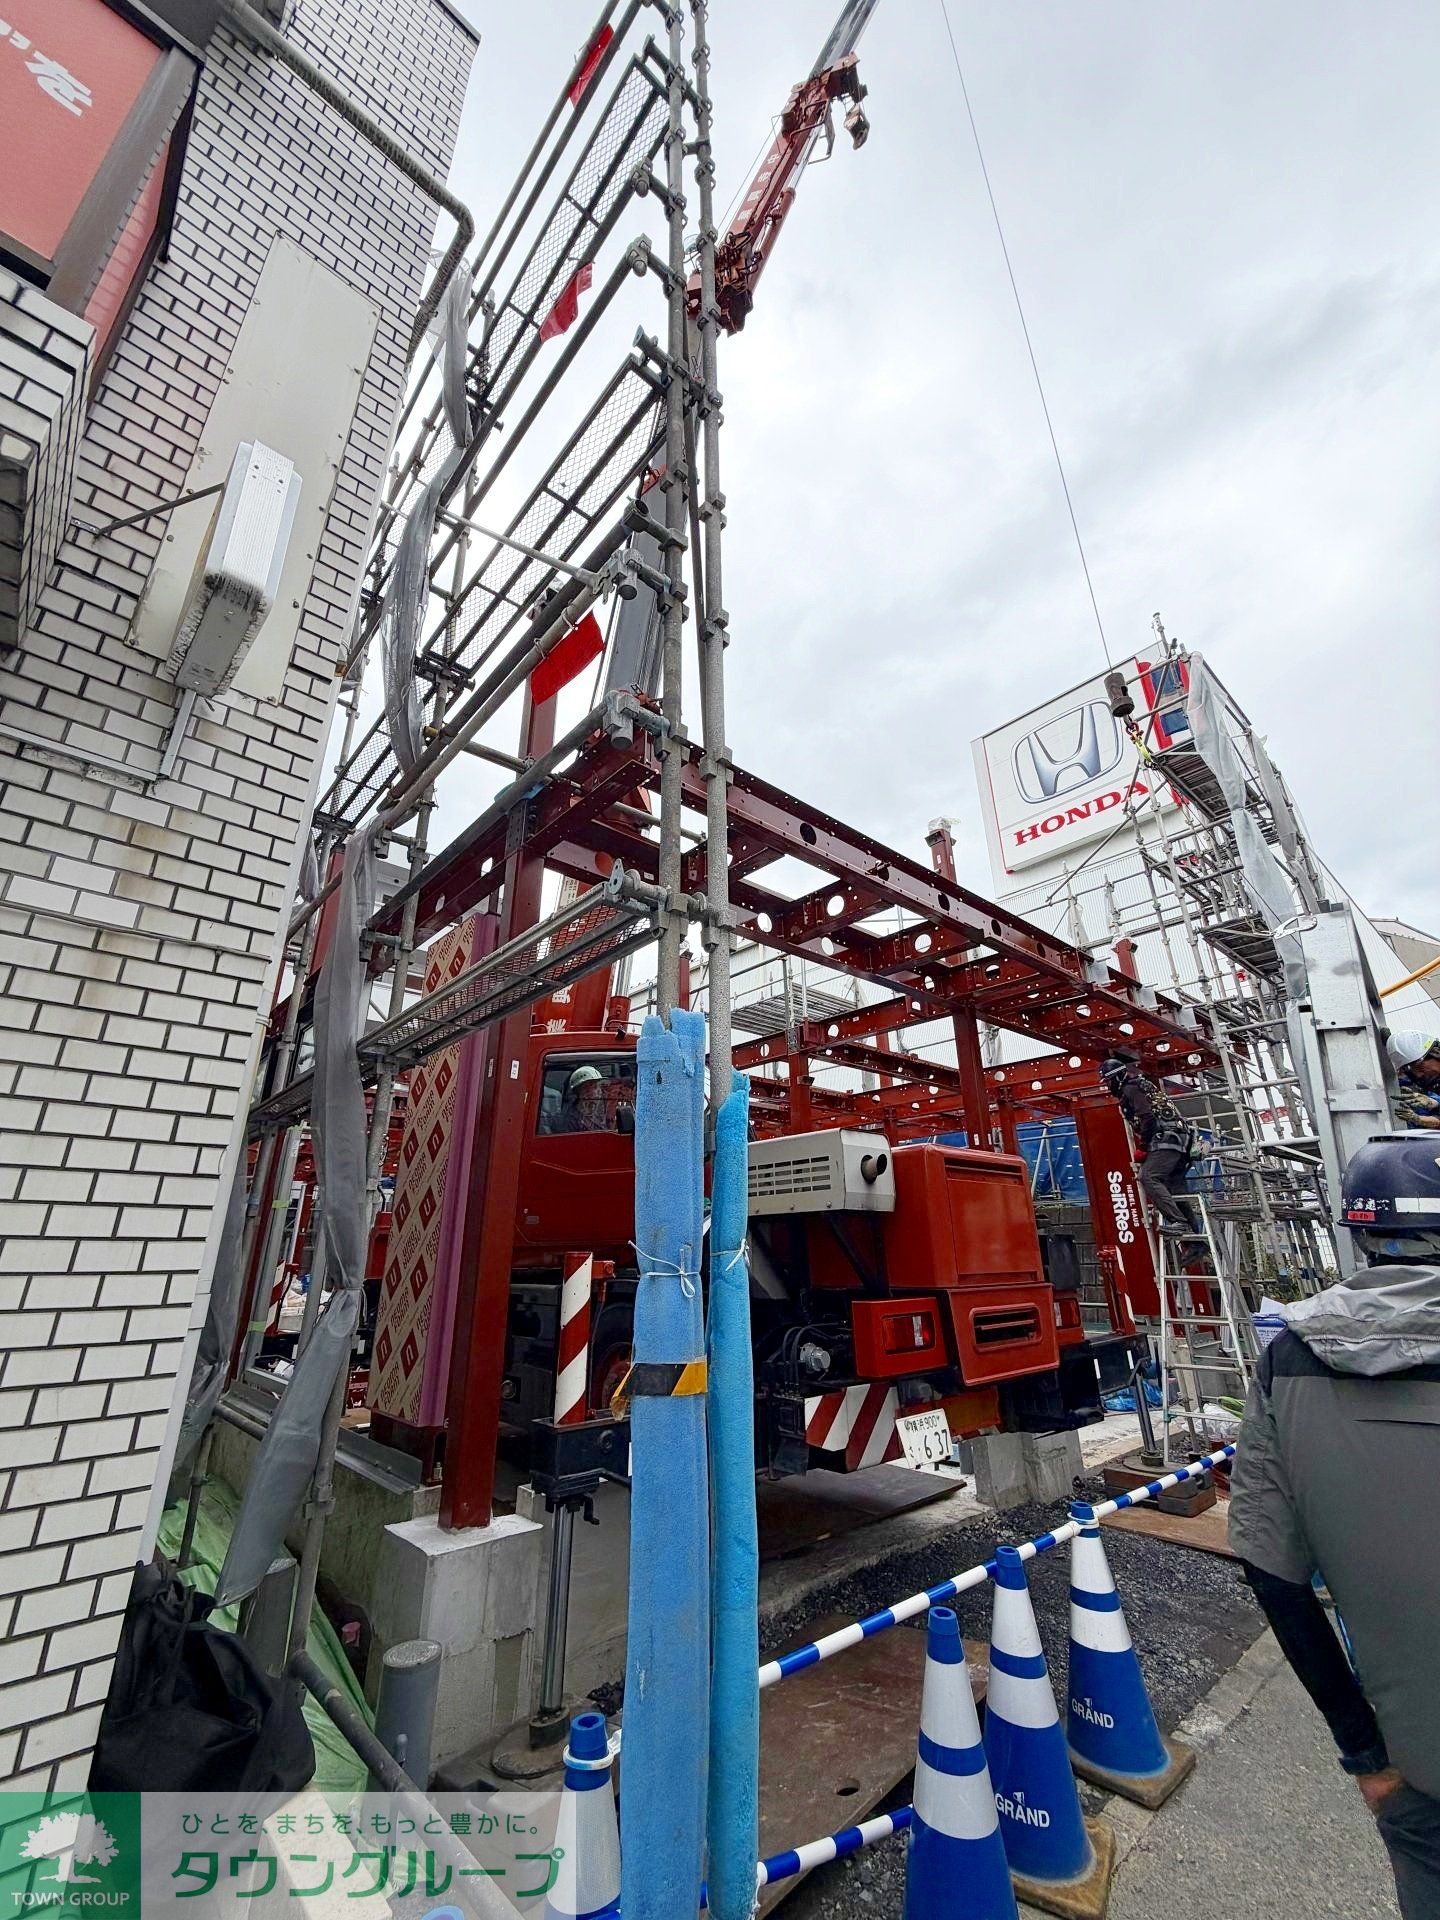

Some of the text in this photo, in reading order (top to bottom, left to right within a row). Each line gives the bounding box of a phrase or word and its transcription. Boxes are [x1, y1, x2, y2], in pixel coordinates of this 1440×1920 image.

[1013, 781, 1149, 847] HONDA
[1071, 1697, 1114, 1729] GRAND
[994, 1792, 1050, 1828] GRAND
